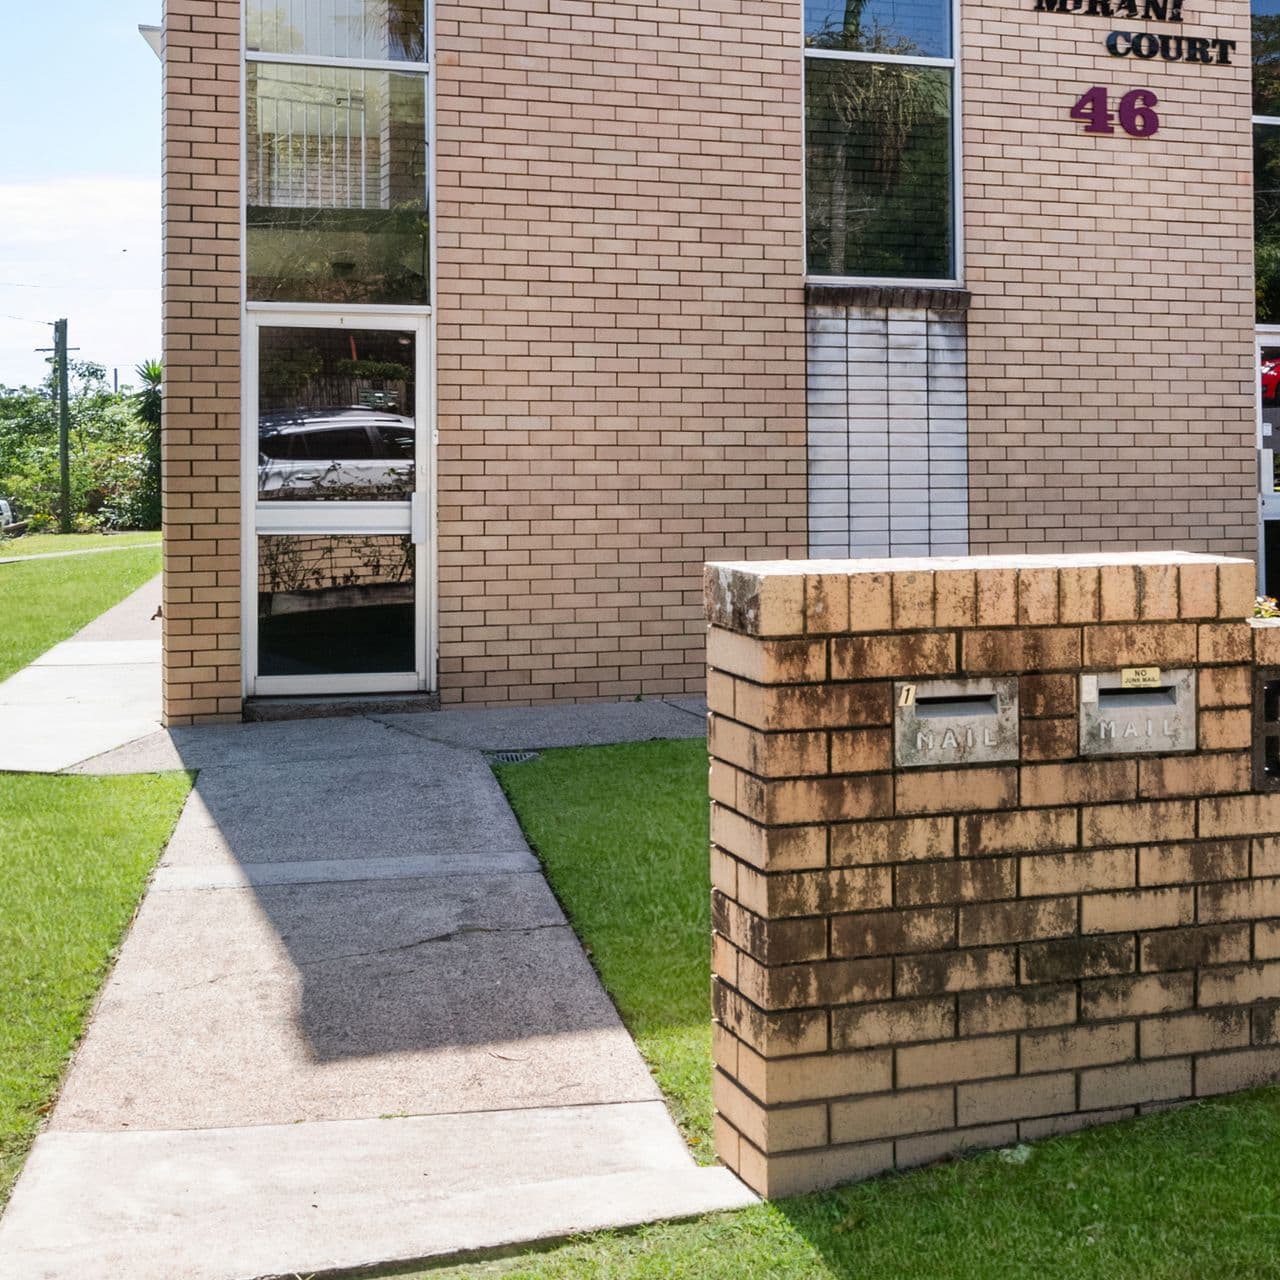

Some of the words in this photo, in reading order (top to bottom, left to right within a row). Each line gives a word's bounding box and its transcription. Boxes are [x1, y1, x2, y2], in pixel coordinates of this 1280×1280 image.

[1106, 31, 1236, 64] COURT
[1070, 86, 1160, 138] 46
[904, 688, 911, 705] 1
[916, 728, 998, 750] MAIL
[1100, 719, 1176, 740] MAIL
